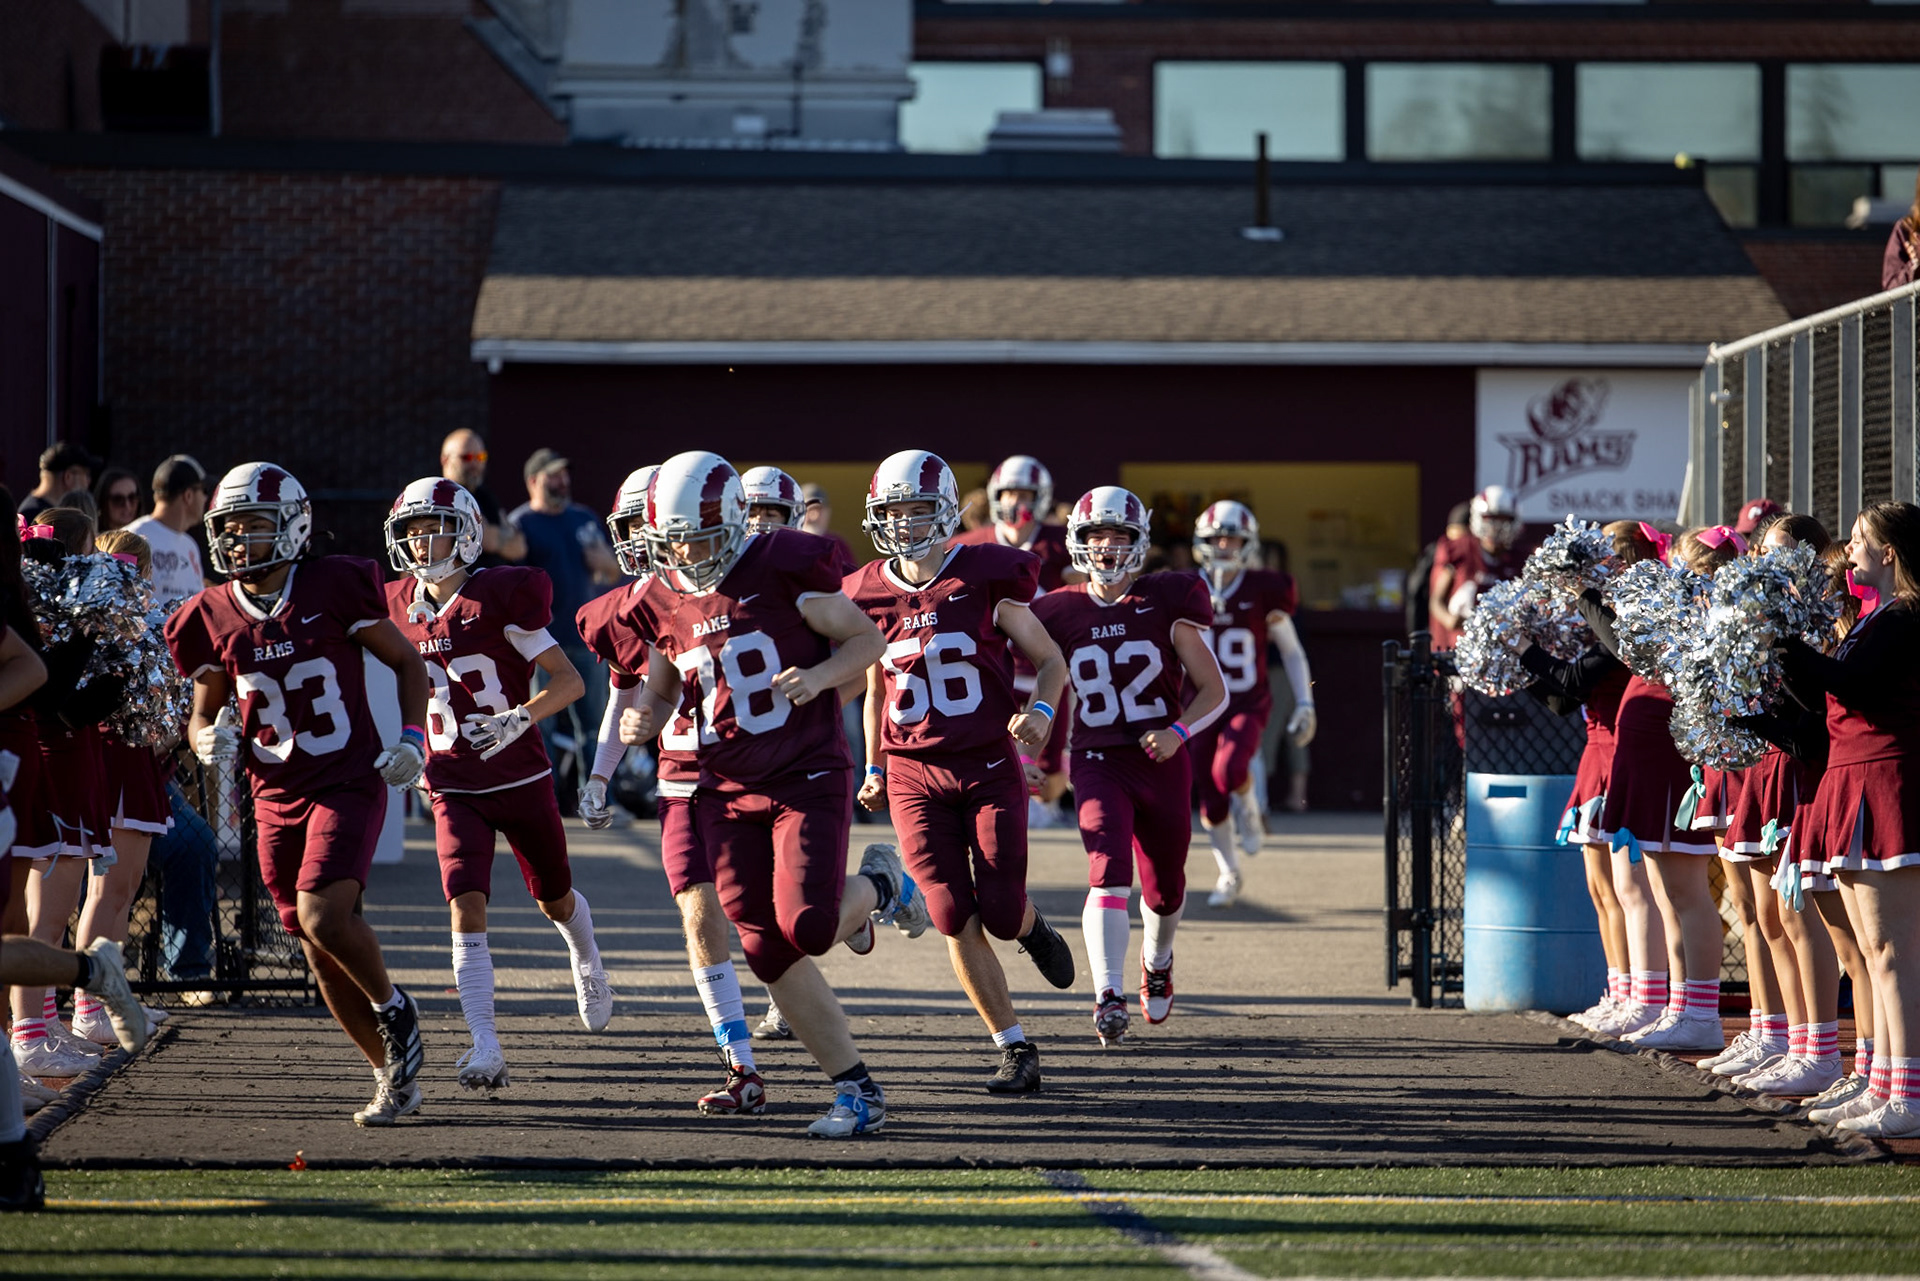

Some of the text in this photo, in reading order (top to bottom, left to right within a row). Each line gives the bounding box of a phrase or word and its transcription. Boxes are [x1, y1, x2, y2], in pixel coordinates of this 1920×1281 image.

[1518, 434, 1625, 489] RAMS
[1548, 488, 1627, 513] SNACK
[692, 615, 730, 639] RAMS
[902, 612, 938, 630] RAMS
[1091, 624, 1126, 639] RAMS
[253, 641, 295, 661] RAMS
[419, 638, 453, 654] RAMS
[1197, 627, 1257, 692] 9
[671, 630, 792, 745] 78
[879, 631, 984, 725] 56
[1069, 640, 1168, 727] 82
[236, 656, 352, 764] 33
